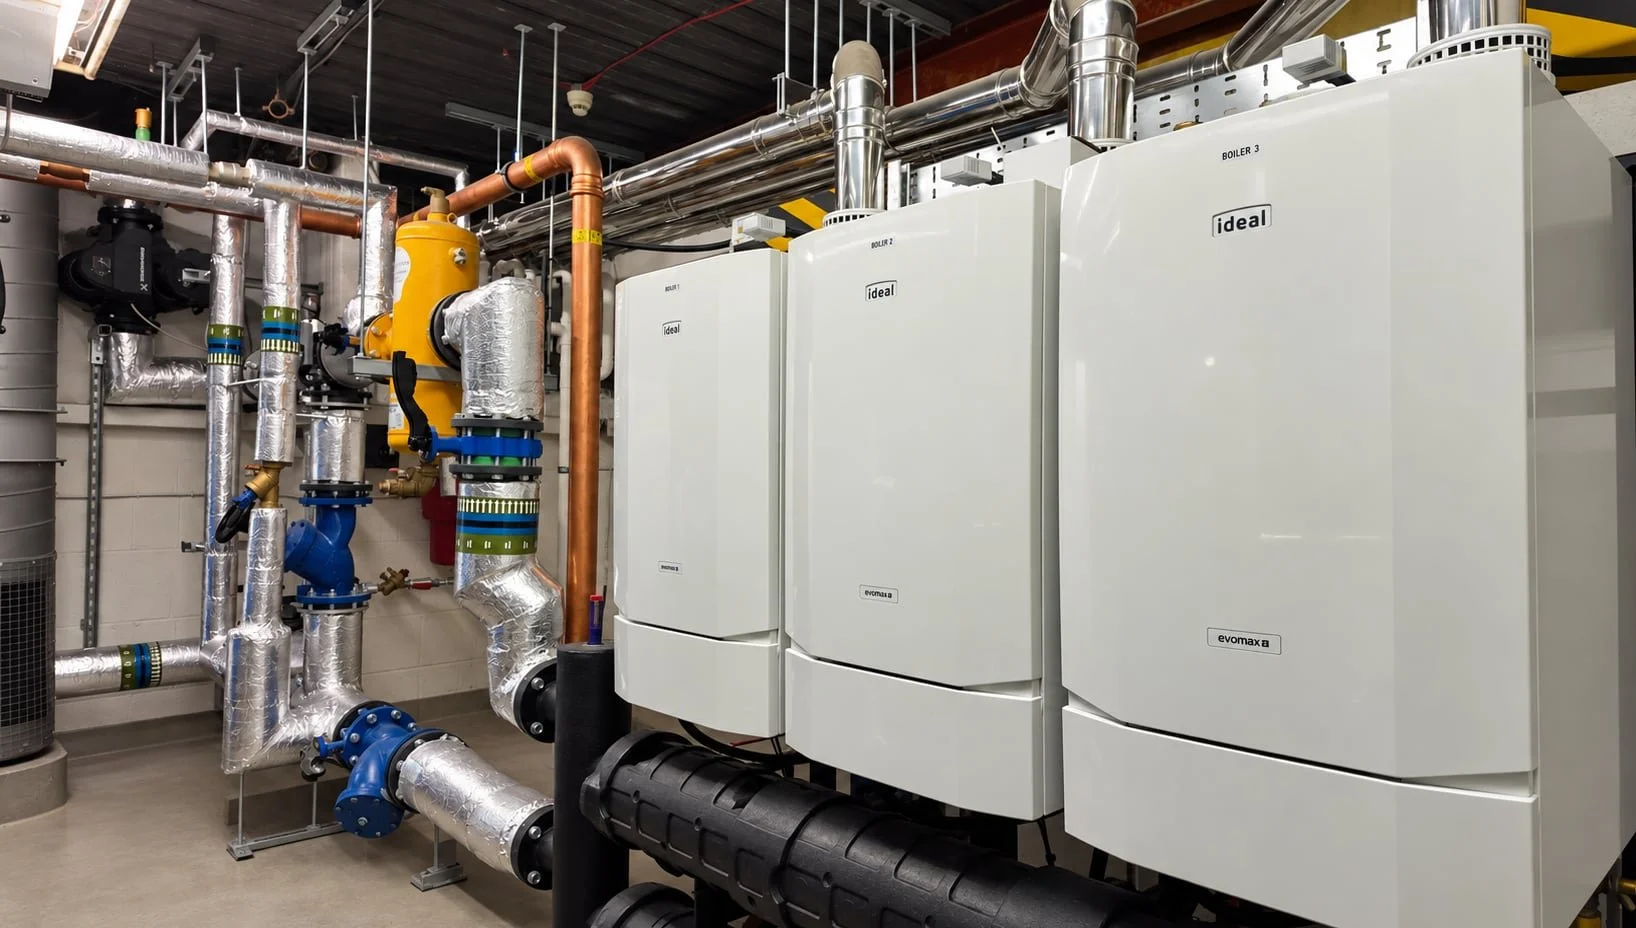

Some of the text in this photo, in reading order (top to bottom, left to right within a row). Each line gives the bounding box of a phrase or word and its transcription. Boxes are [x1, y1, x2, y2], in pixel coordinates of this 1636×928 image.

[1222, 144, 1260, 160] BOILER 3
[1217, 209, 1266, 234] ideal
[868, 283, 894, 300] ideal
[663, 323, 680, 336] ideal
